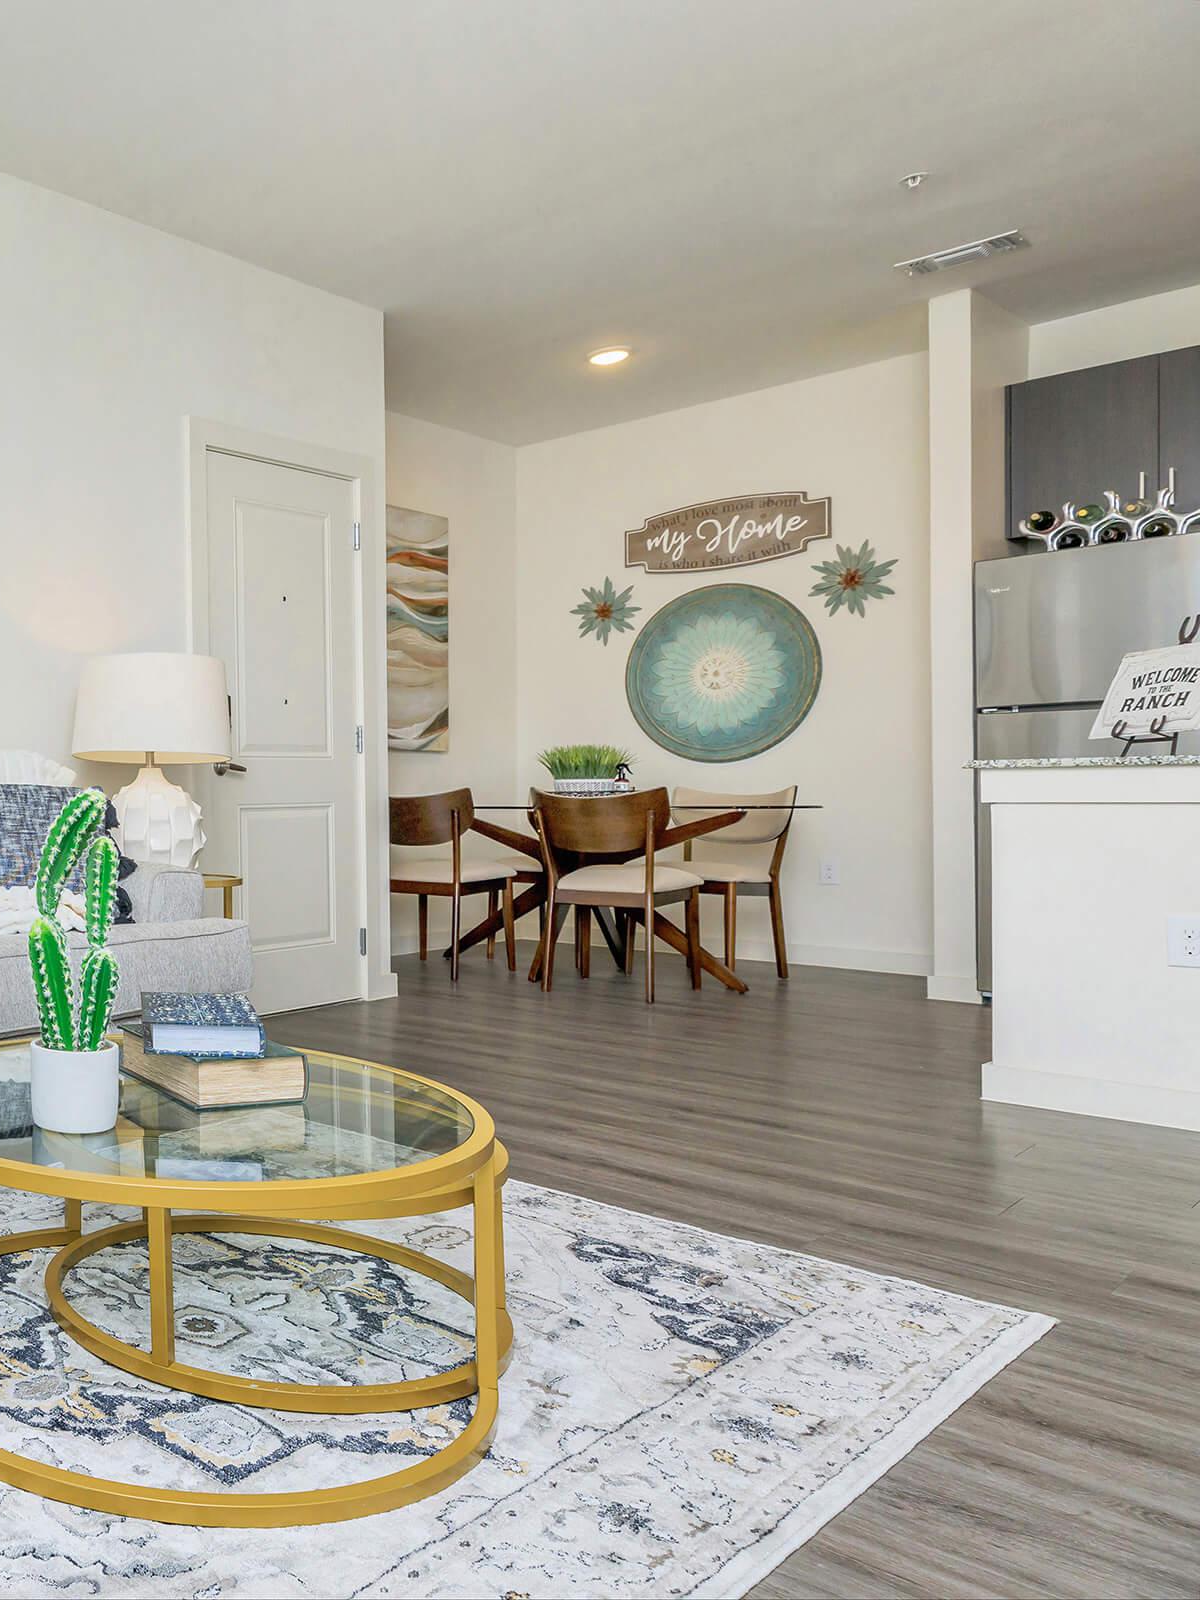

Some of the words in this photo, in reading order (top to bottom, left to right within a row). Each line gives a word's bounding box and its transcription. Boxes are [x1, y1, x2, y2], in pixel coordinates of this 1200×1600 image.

[651, 515, 681, 530] what
[691, 508, 718, 519] love
[722, 500, 754, 513] most
[759, 496, 798, 509] about
[646, 528, 692, 561] my
[696, 513, 808, 554] Home
[658, 559, 668, 569] is
[672, 557, 698, 569] who
[711, 554, 744, 566] share
[747, 549, 757, 560] it
[760, 541, 791, 556] with
[1131, 666, 1200, 689] WELCOME
[1159, 685, 1174, 693] THE
[1120, 690, 1191, 713] RANCH
